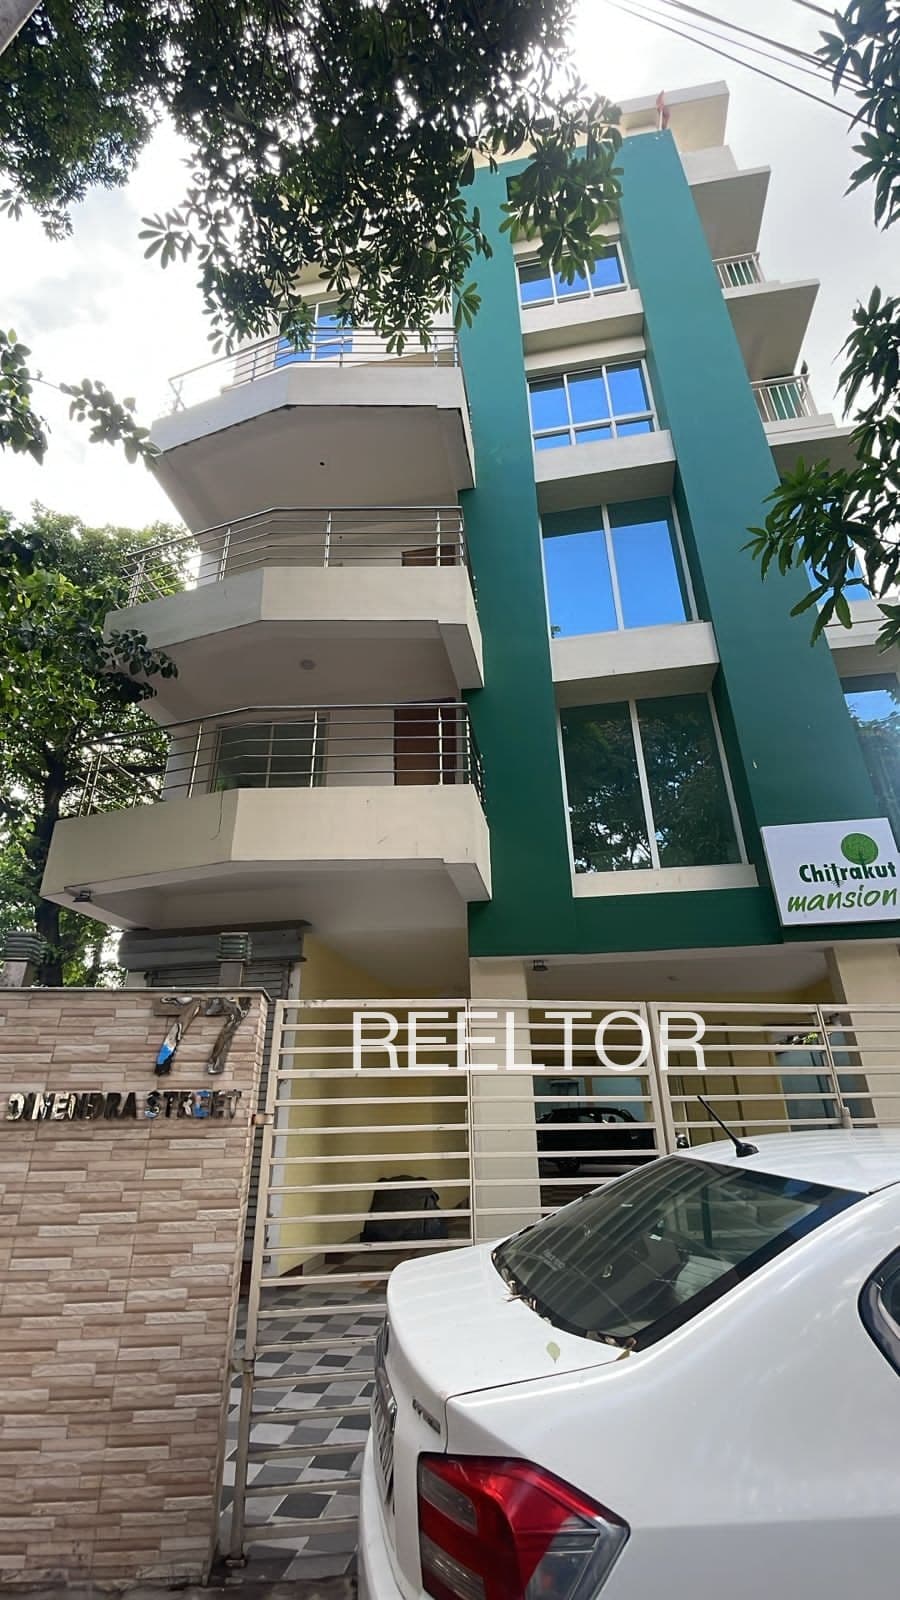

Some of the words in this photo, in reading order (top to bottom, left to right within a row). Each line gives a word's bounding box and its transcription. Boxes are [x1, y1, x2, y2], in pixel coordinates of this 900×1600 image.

[799, 862, 897, 888] Chitrakut
[787, 885, 898, 913] mansion
[153, 996, 251, 1076] 77
[6, 1091, 137, 1121] DINENDRA
[144, 1089, 242, 1120] STREET
